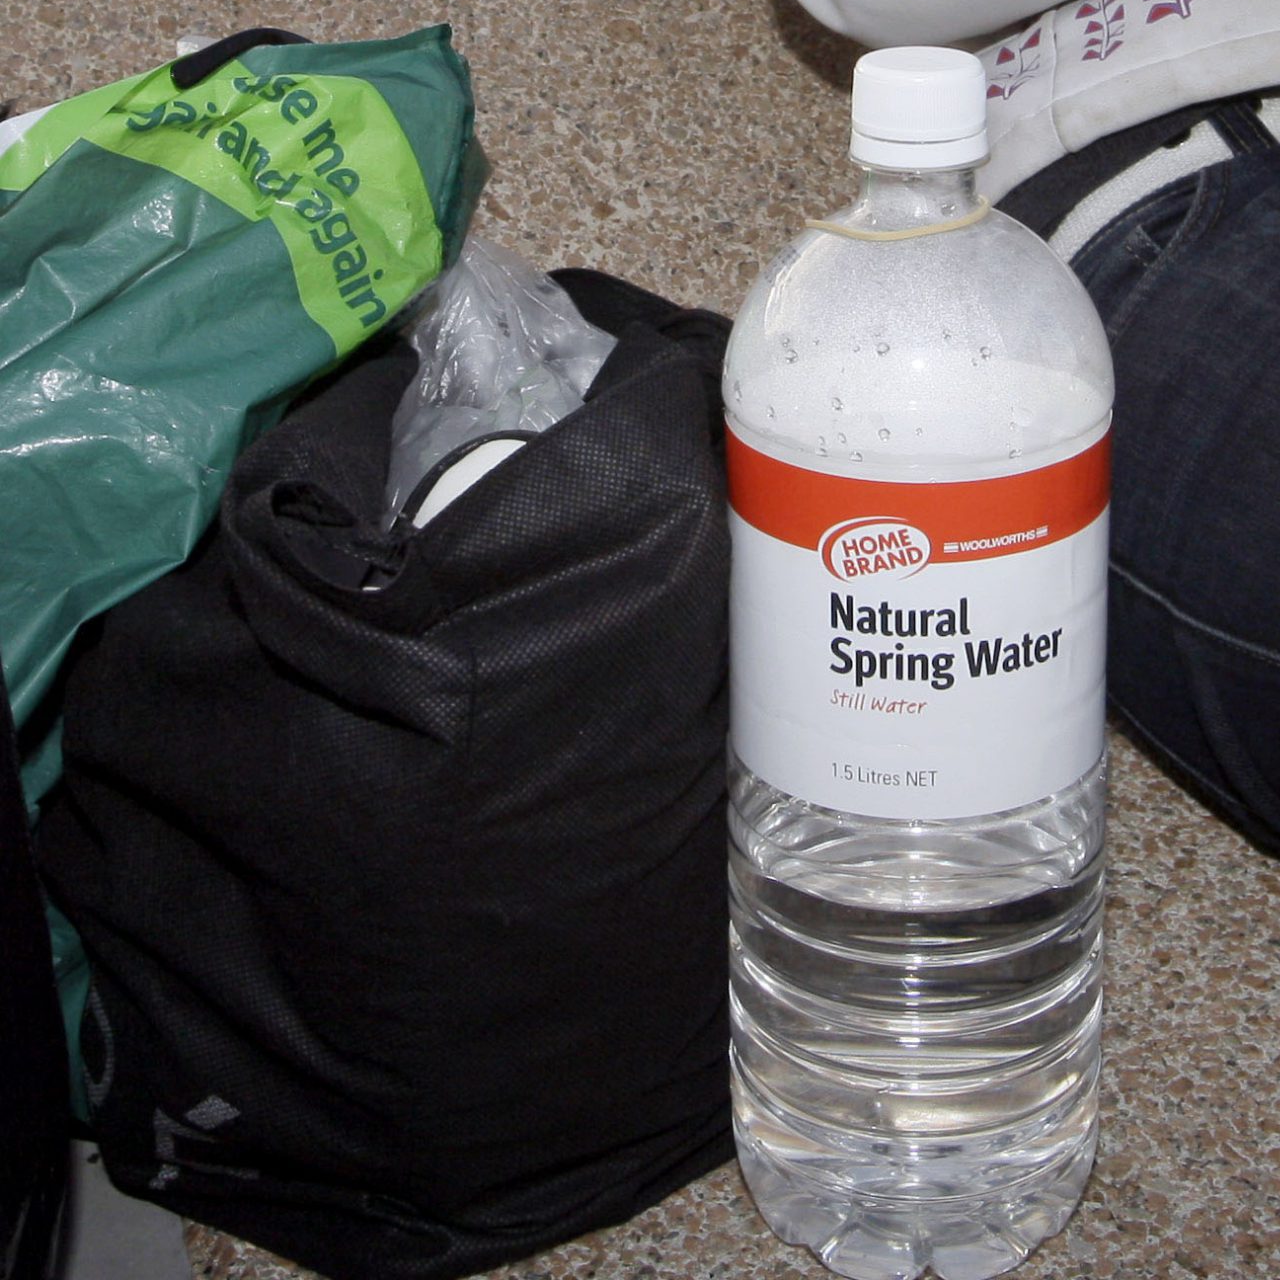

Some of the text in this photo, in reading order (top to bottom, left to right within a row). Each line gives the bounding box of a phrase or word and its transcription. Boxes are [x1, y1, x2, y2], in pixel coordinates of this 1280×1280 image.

[216, 120, 303, 200] and
[295, 187, 387, 329] again
[841, 528, 912, 558] HOME
[959, 529, 1036, 552] WOOLWORTHS
[842, 546, 924, 578] BRAND
[830, 591, 971, 637] Natural
[830, 627, 1063, 690] Spring Water
[830, 688, 928, 715] Still Water
[831, 762, 939, 787] 1.5 Litres NET
